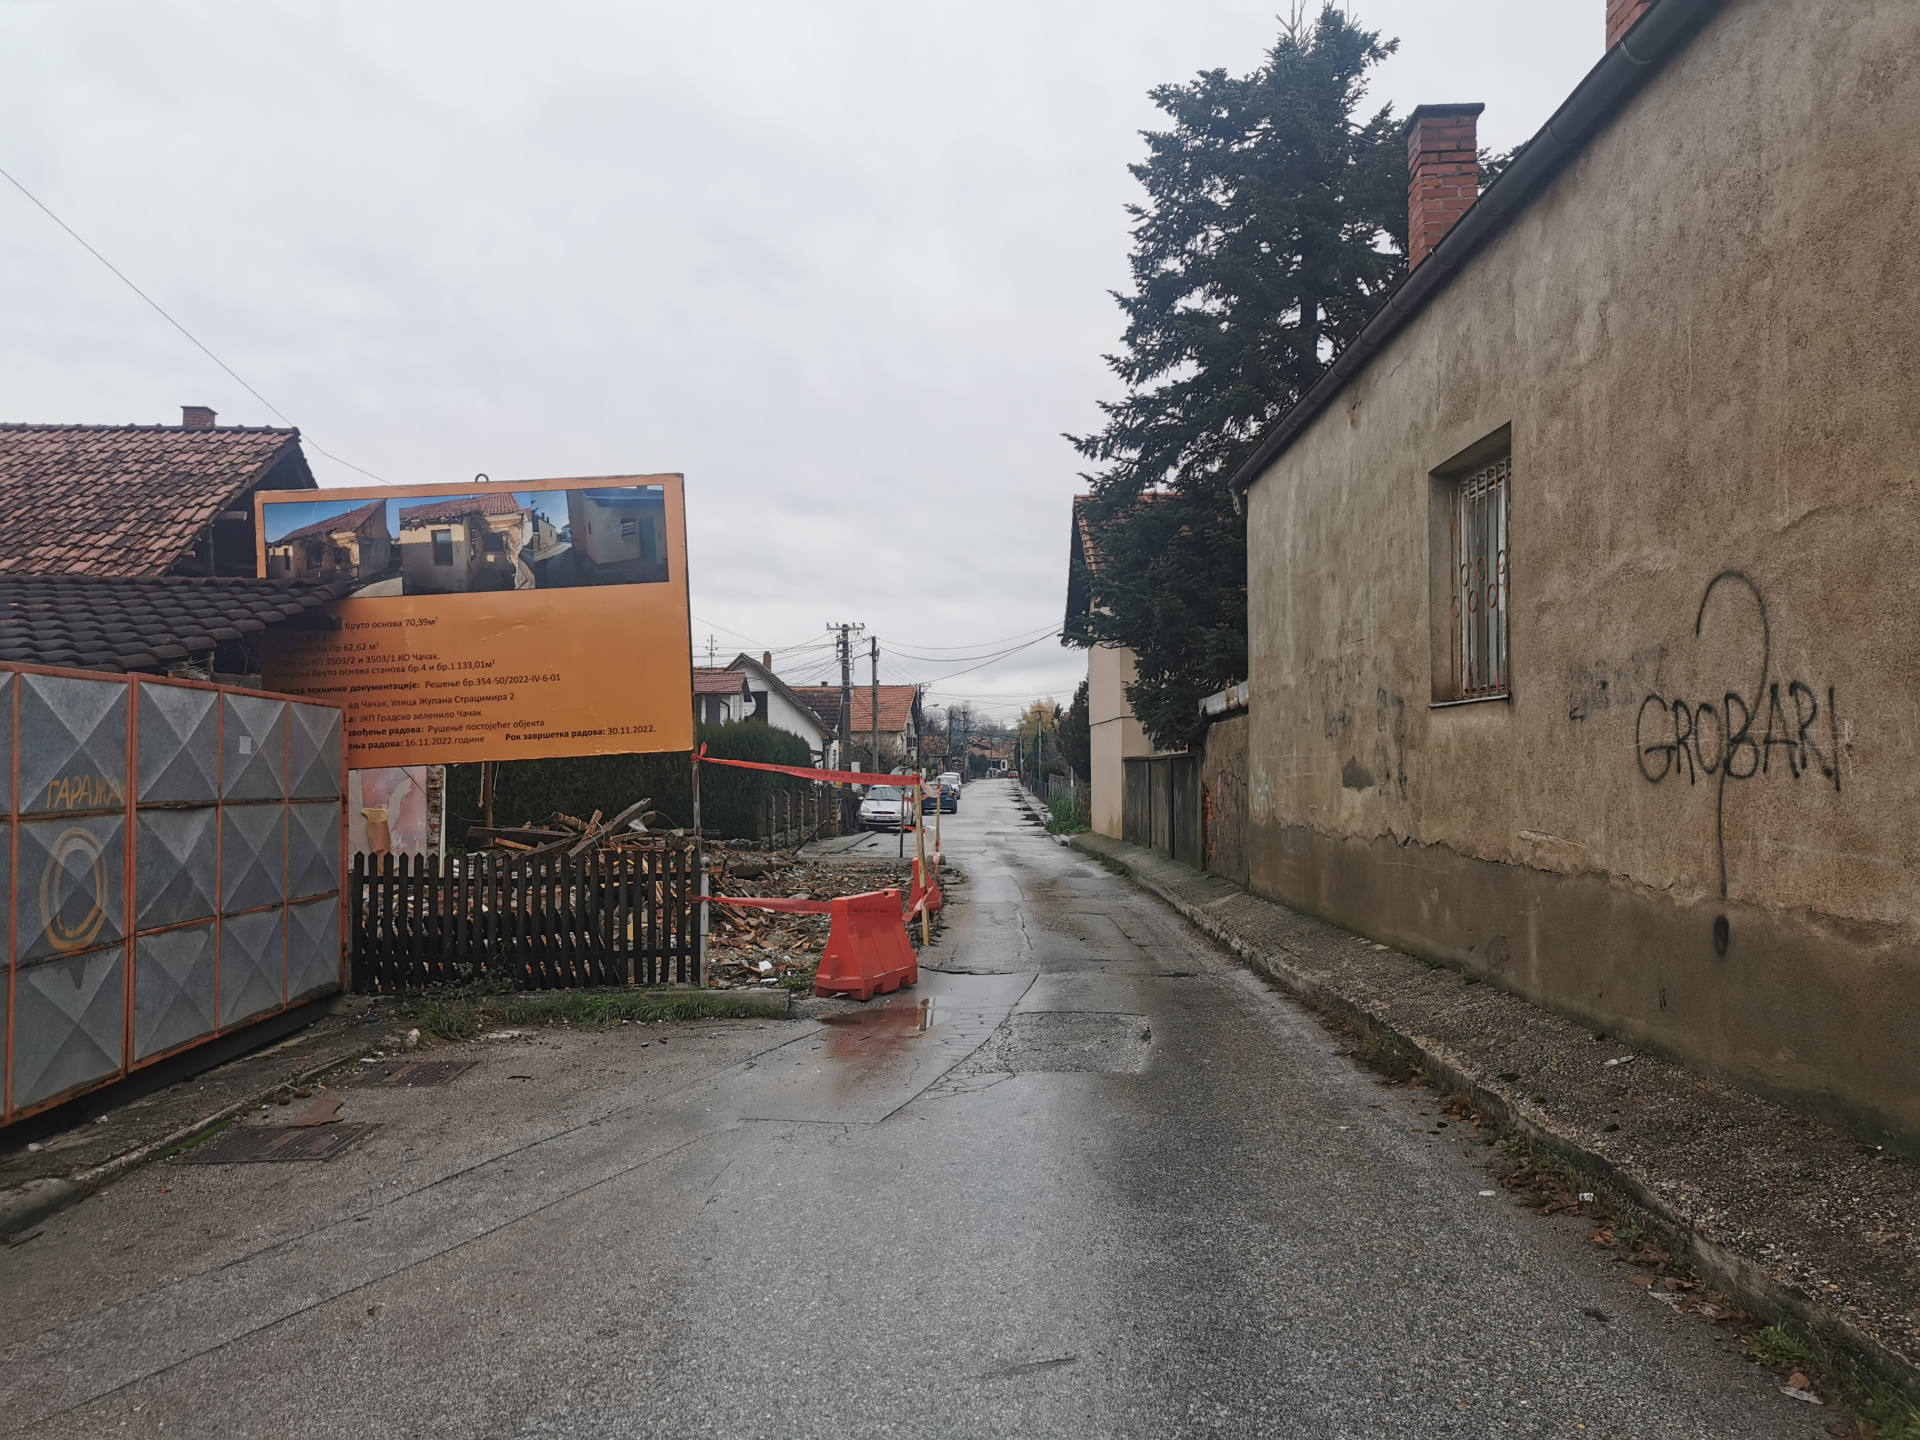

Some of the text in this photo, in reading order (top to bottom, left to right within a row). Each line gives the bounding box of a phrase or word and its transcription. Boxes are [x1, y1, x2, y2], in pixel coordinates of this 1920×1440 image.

[345, 621, 369, 631] бруто
[372, 621, 402, 629] основа
[330, 644, 341, 653] Пр
[344, 643, 367, 652] 62,62
[312, 658, 323, 666] КП
[326, 656, 356, 665] 3503/2
[366, 654, 395, 664] 3503/1
[398, 653, 411, 662] КО
[413, 653, 440, 661] Чачак.
[312, 668, 337, 678] бруто
[408, 664, 426, 674] бр.4
[437, 663, 455, 673] бр.1
[307, 685, 348, 693] техничке
[350, 680, 420, 694] документације:
[425, 680, 460, 688] Решење
[391, 699, 417, 708] Улица
[419, 697, 452, 706] Жупана
[454, 694, 508, 704] Страцимира
[510, 692, 515, 700] 2
[359, 715, 375, 723] ЈКП
[378, 714, 411, 723] Градско
[413, 711, 455, 720] зеленило
[389, 727, 424, 736] радова:
[428, 725, 463, 734] Рушење
[465, 721, 511, 731] постојећег
[513, 720, 544, 729] објекта
[368, 742, 403, 751] радова:
[505, 733, 521, 741] Рок
[523, 731, 569, 740] завршетка
[571, 729, 606, 738] радова:
[608, 725, 656, 735] 30.11.2022.
